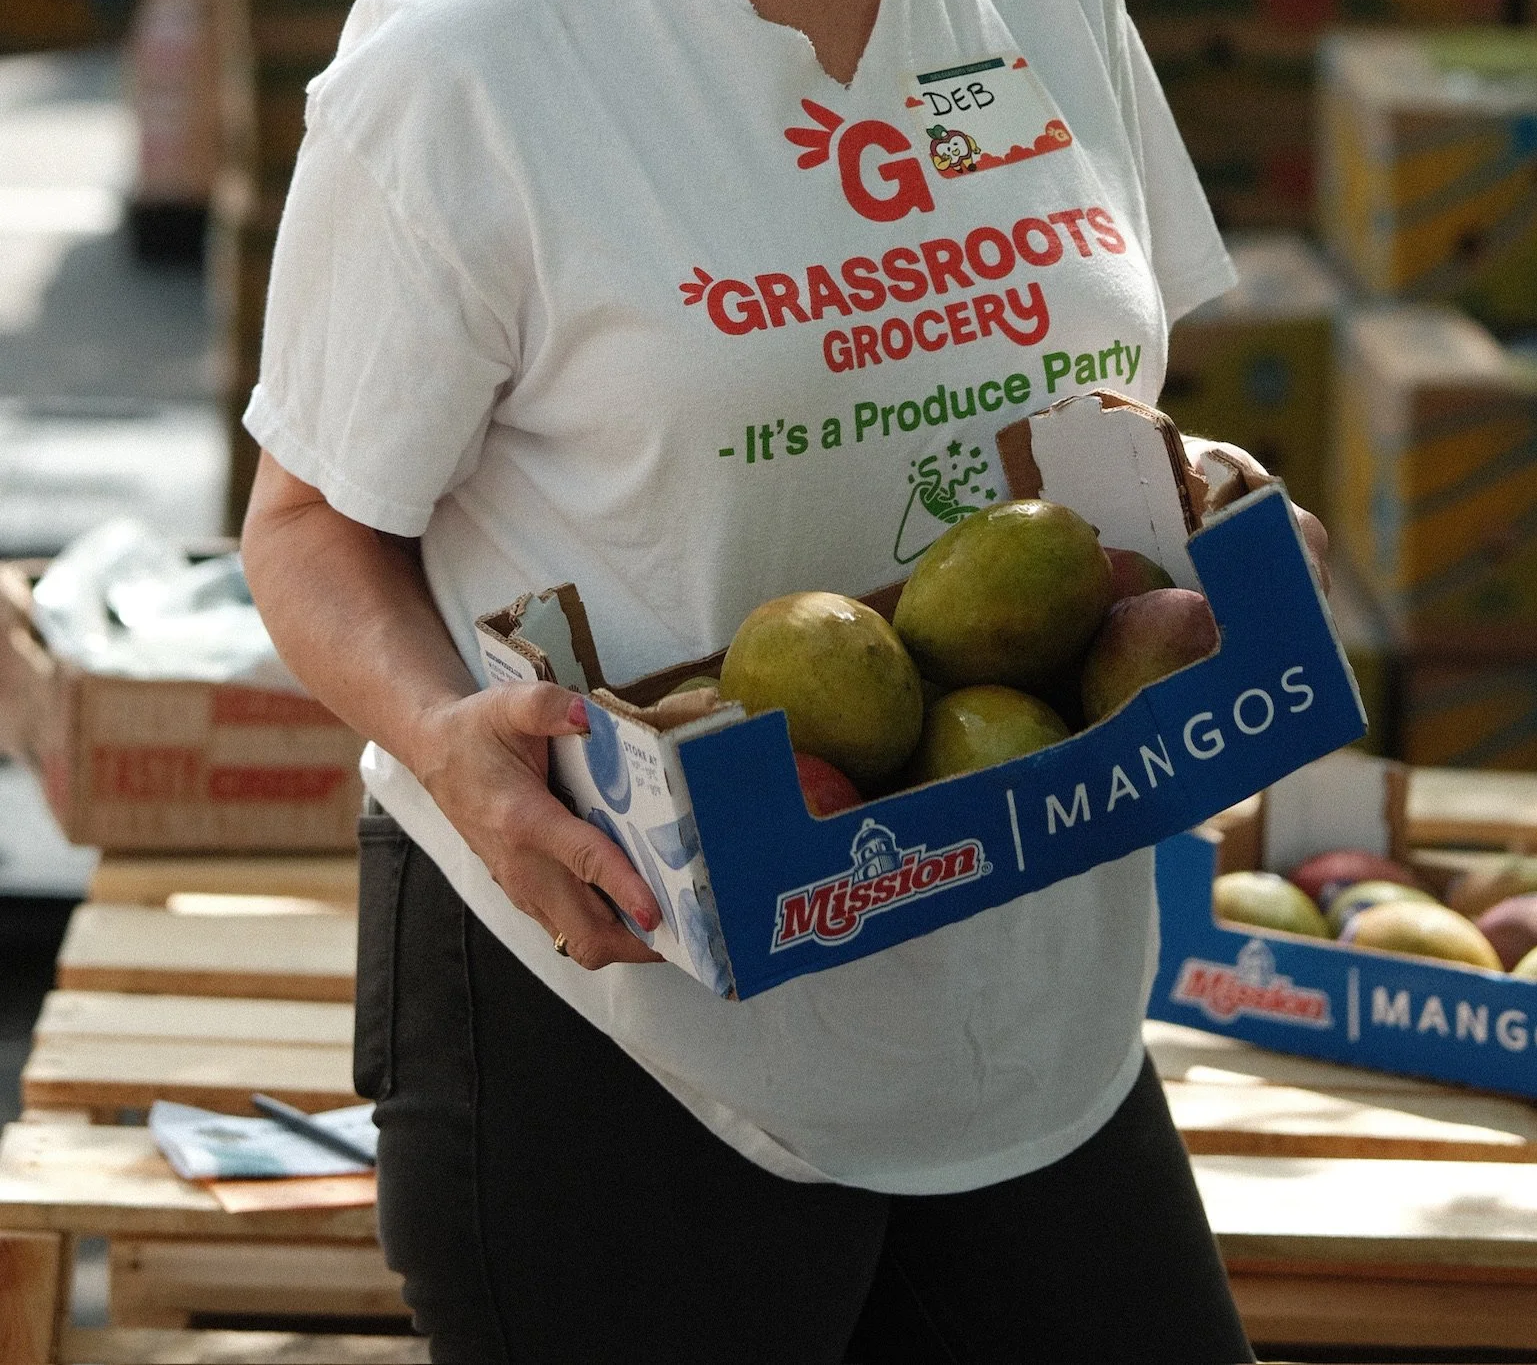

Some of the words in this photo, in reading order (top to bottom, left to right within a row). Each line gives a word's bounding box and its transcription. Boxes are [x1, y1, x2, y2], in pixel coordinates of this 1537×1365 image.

[922, 82, 995, 116] DEB
[837, 119, 936, 222] G
[706, 206, 1127, 336] GRASSROOTS
[822, 281, 1051, 373] GROCERY
[821, 417, 842, 450] a
[854, 374, 1031, 443] Produce
[1042, 339, 1142, 394] Party
[776, 842, 980, 945] Mission
[1045, 665, 1315, 835] MANGOS
[1371, 985, 1537, 1051] MANG
